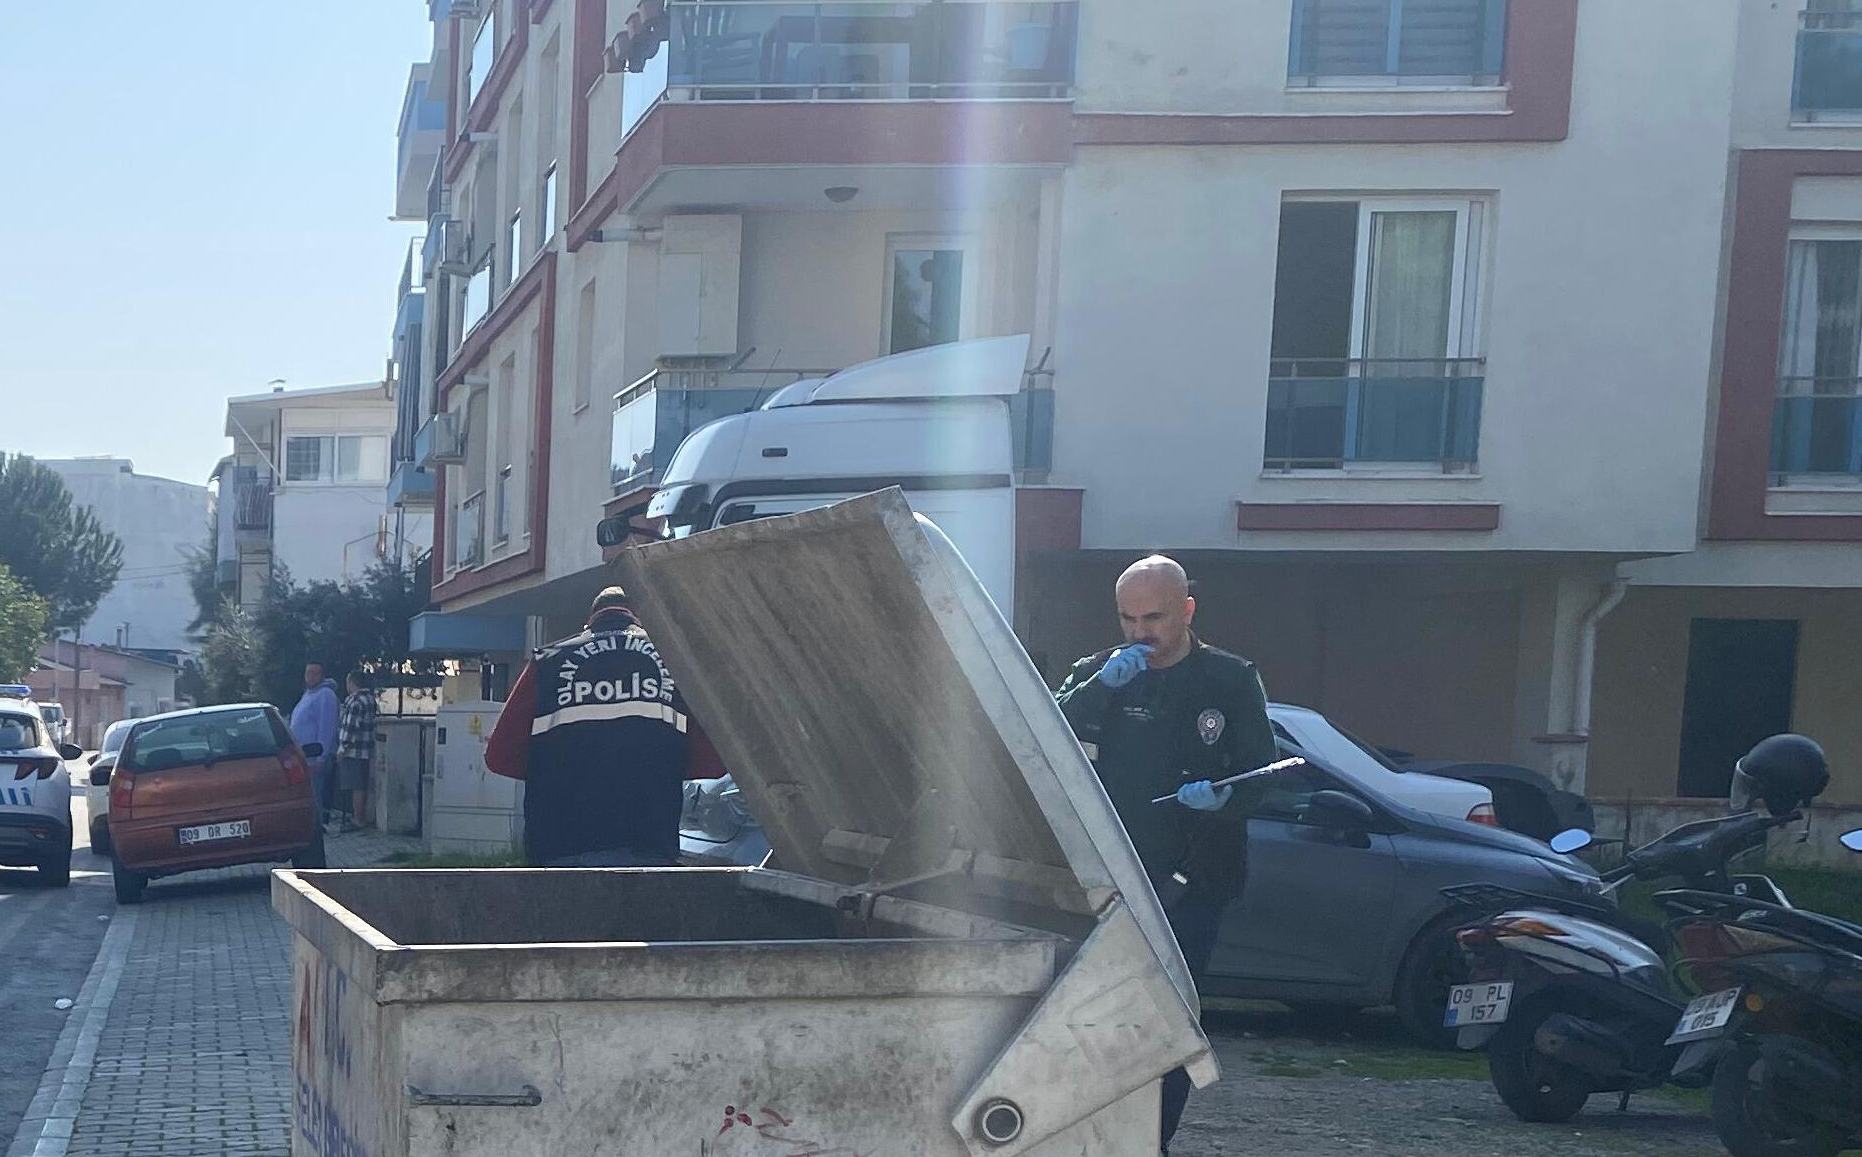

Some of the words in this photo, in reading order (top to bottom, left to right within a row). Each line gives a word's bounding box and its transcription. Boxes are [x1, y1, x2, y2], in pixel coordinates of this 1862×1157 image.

[558, 659, 579, 705] OLAY
[575, 672, 659, 704] POLİS
[187, 829, 200, 840] 09
[229, 822, 249, 835] 520
[1453, 989, 1474, 1004] 09
[1471, 1004, 1497, 1020] 157
